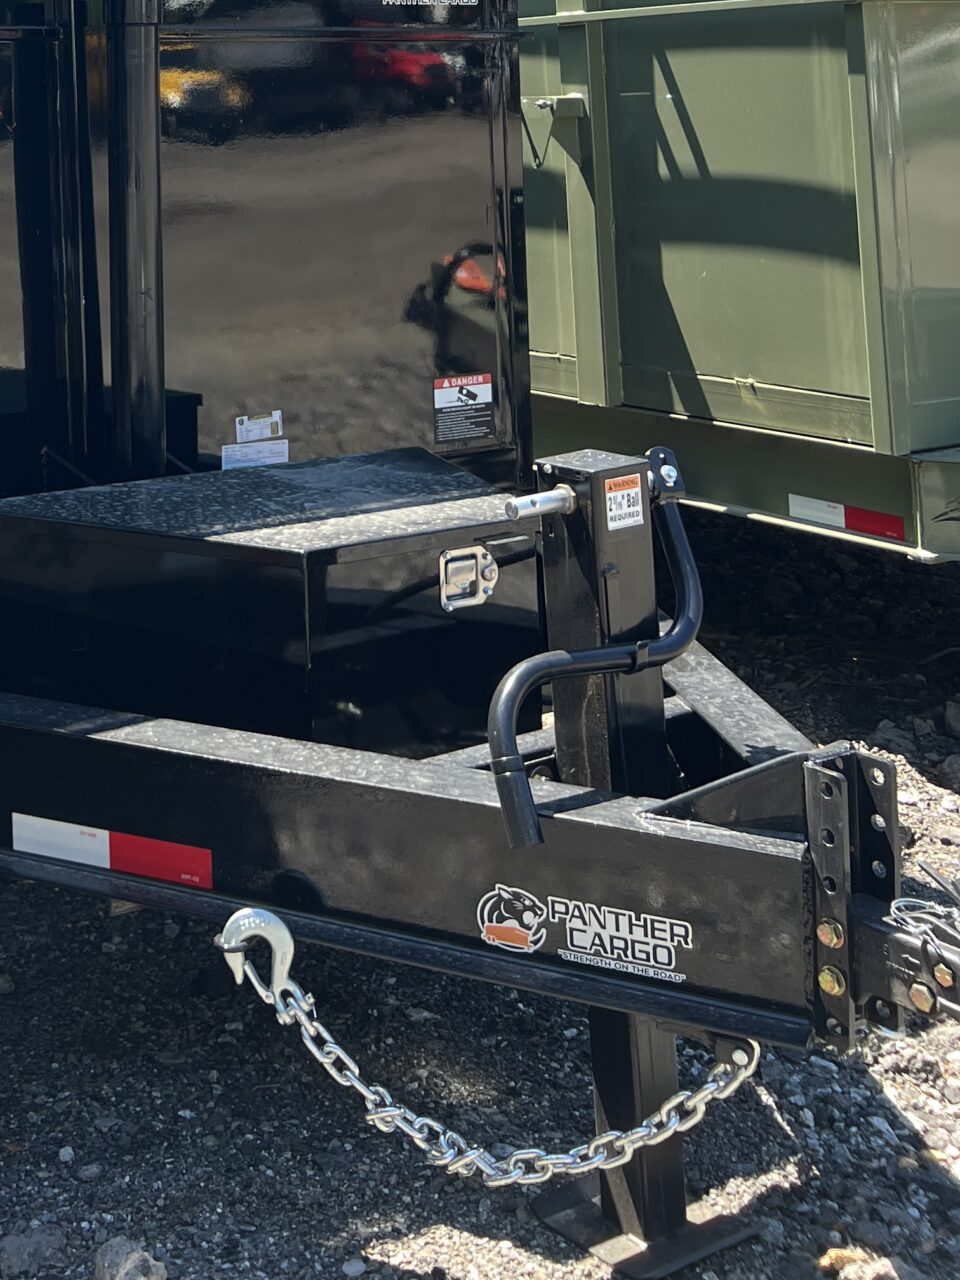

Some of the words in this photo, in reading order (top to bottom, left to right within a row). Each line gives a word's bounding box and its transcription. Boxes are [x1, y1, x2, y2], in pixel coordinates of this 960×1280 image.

[451, 375, 484, 387] DANGER
[613, 477, 638, 489] WARNING
[626, 491, 640, 508] Ball
[609, 510, 640, 523] REQUIRED
[548, 896, 692, 948] PANTHER
[567, 925, 674, 969] CARGO
[613, 961, 629, 972] ON
[631, 965, 651, 977] THE
